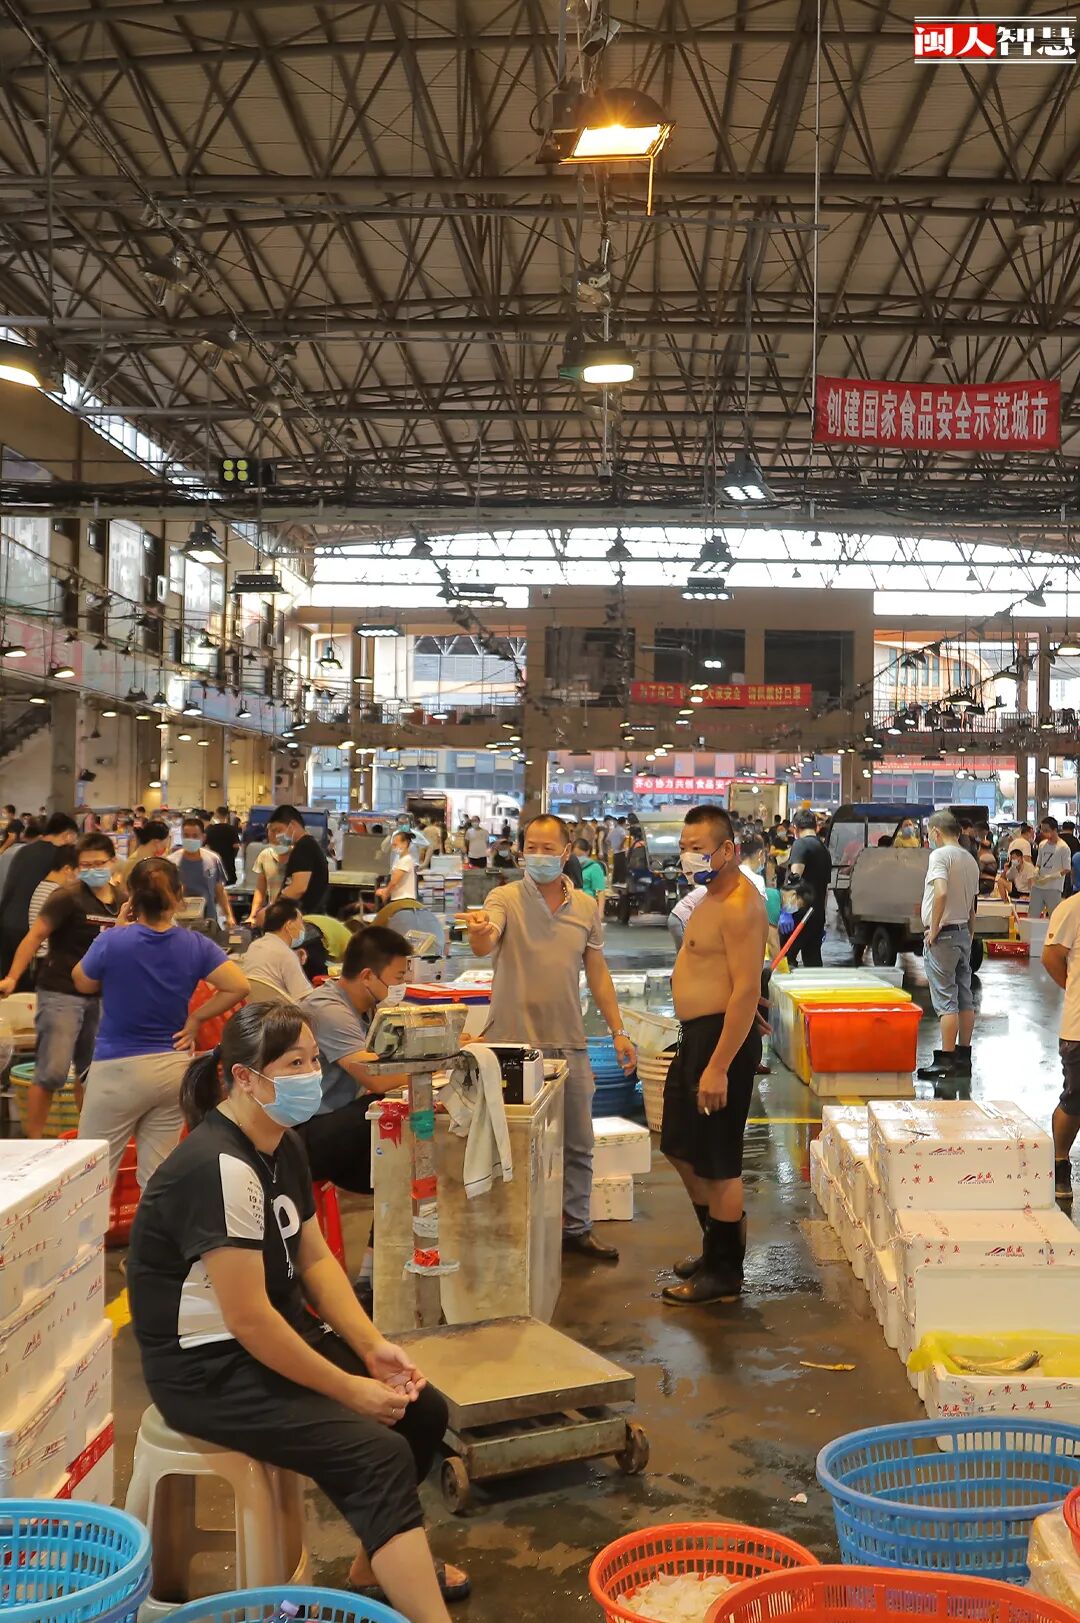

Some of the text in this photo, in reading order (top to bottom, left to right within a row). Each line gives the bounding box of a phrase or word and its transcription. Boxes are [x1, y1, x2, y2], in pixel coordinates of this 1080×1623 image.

[827, 388, 1049, 441] 创建国家食品安全示范城市
